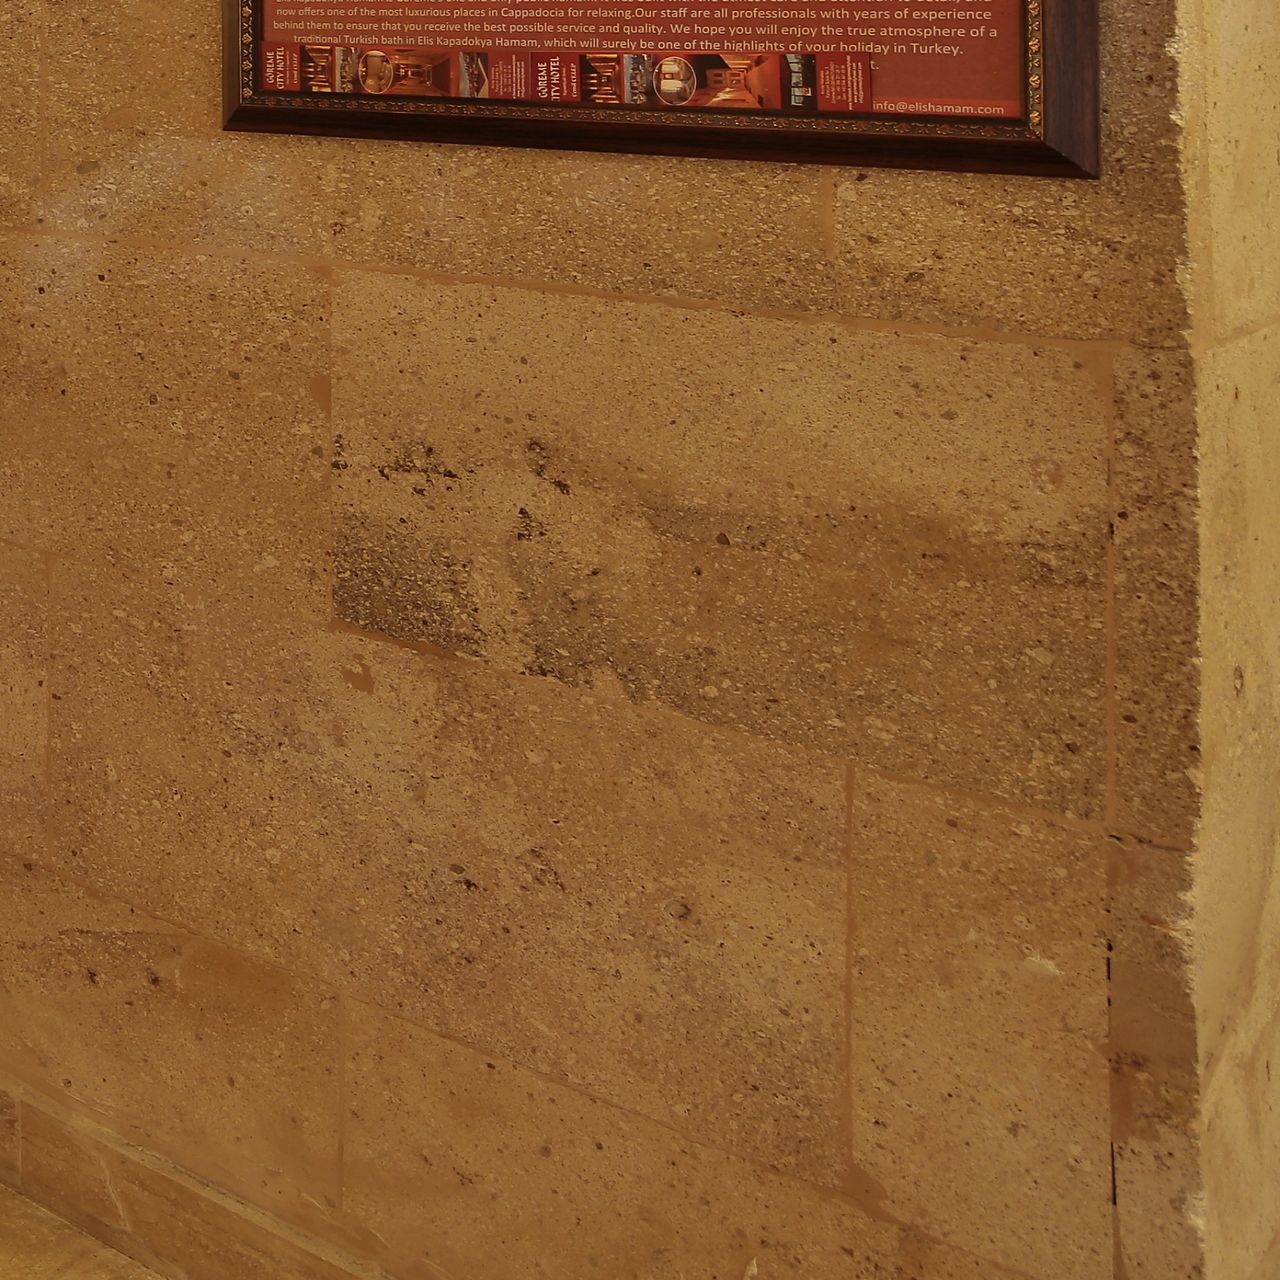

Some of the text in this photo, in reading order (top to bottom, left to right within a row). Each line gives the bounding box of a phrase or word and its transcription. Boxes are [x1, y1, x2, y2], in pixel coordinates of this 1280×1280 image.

[277, 8, 295, 16] now
[299, 5, 324, 16] offers
[328, 8, 344, 16] one
[348, 5, 357, 16] of
[361, 5, 375, 16] the
[379, 5, 402, 16] most
[406, 6, 450, 16] luxurious
[454, 6, 485, 20] places
[489, 6, 497, 17] in
[501, 6, 564, 20] Cappadocia
[568, 6, 583, 17] for
[661, 7, 687, 18] staff
[691, 10, 710, 18] are
[714, 7, 727, 18] all
[732, 7, 816, 21] professionals
[821, 7, 849, 18] with
[854, 10, 889, 22] years
[895, 7, 908, 18] of
[913, 7, 991, 22] experience
[274, 19, 303, 30] behind
[307, 19, 330, 30] them
[334, 20, 343, 31] to
[347, 23, 378, 31] ensure
[382, 20, 400, 31] that
[404, 23, 421, 35] you
[425, 20, 460, 32] receive
[464, 21, 480, 32] the
[484, 21, 506, 32] best
[510, 21, 553, 36] possible
[557, 22, 595, 33] service
[599, 22, 619, 33] and
[624, 22, 665, 37] quality.
[671, 23, 690, 34] We
[695, 23, 725, 38] hope
[729, 26, 751, 38] you
[756, 23, 777, 34] will
[782, 24, 817, 38] enjoy
[822, 24, 842, 35] the
[848, 24, 875, 35] true
[880, 24, 965, 39] atmosphere
[970, 25, 985, 36] of
[294, 33, 636, 53] traditional Turkish bath in Elis Kapadokya Hamam, which will surely
[550, 56, 560, 80] HOTEL
[872, 101, 1004, 114] info@elishamam.com
